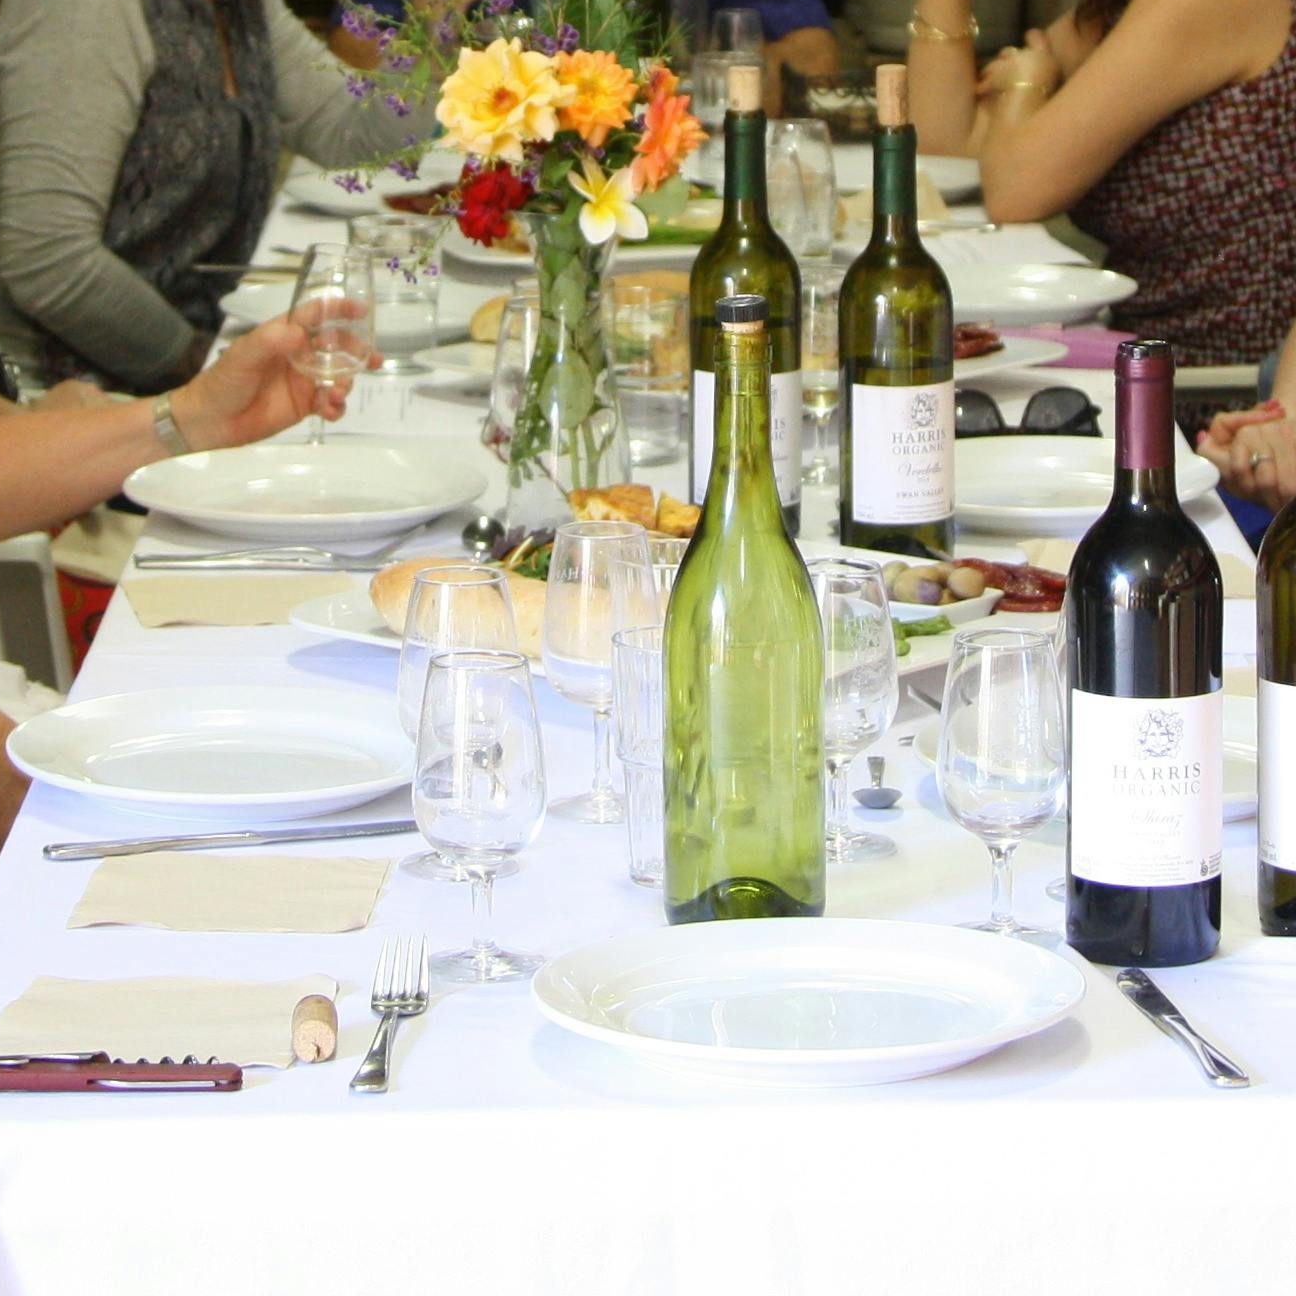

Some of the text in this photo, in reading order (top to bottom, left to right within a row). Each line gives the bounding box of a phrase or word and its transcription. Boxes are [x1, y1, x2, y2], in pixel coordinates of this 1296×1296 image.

[891, 429, 945, 444] HARRIS
[891, 443, 944, 455] ORGANIC
[1113, 762, 1201, 780] HARRIS
[1112, 781, 1201, 797] ORGANIC
